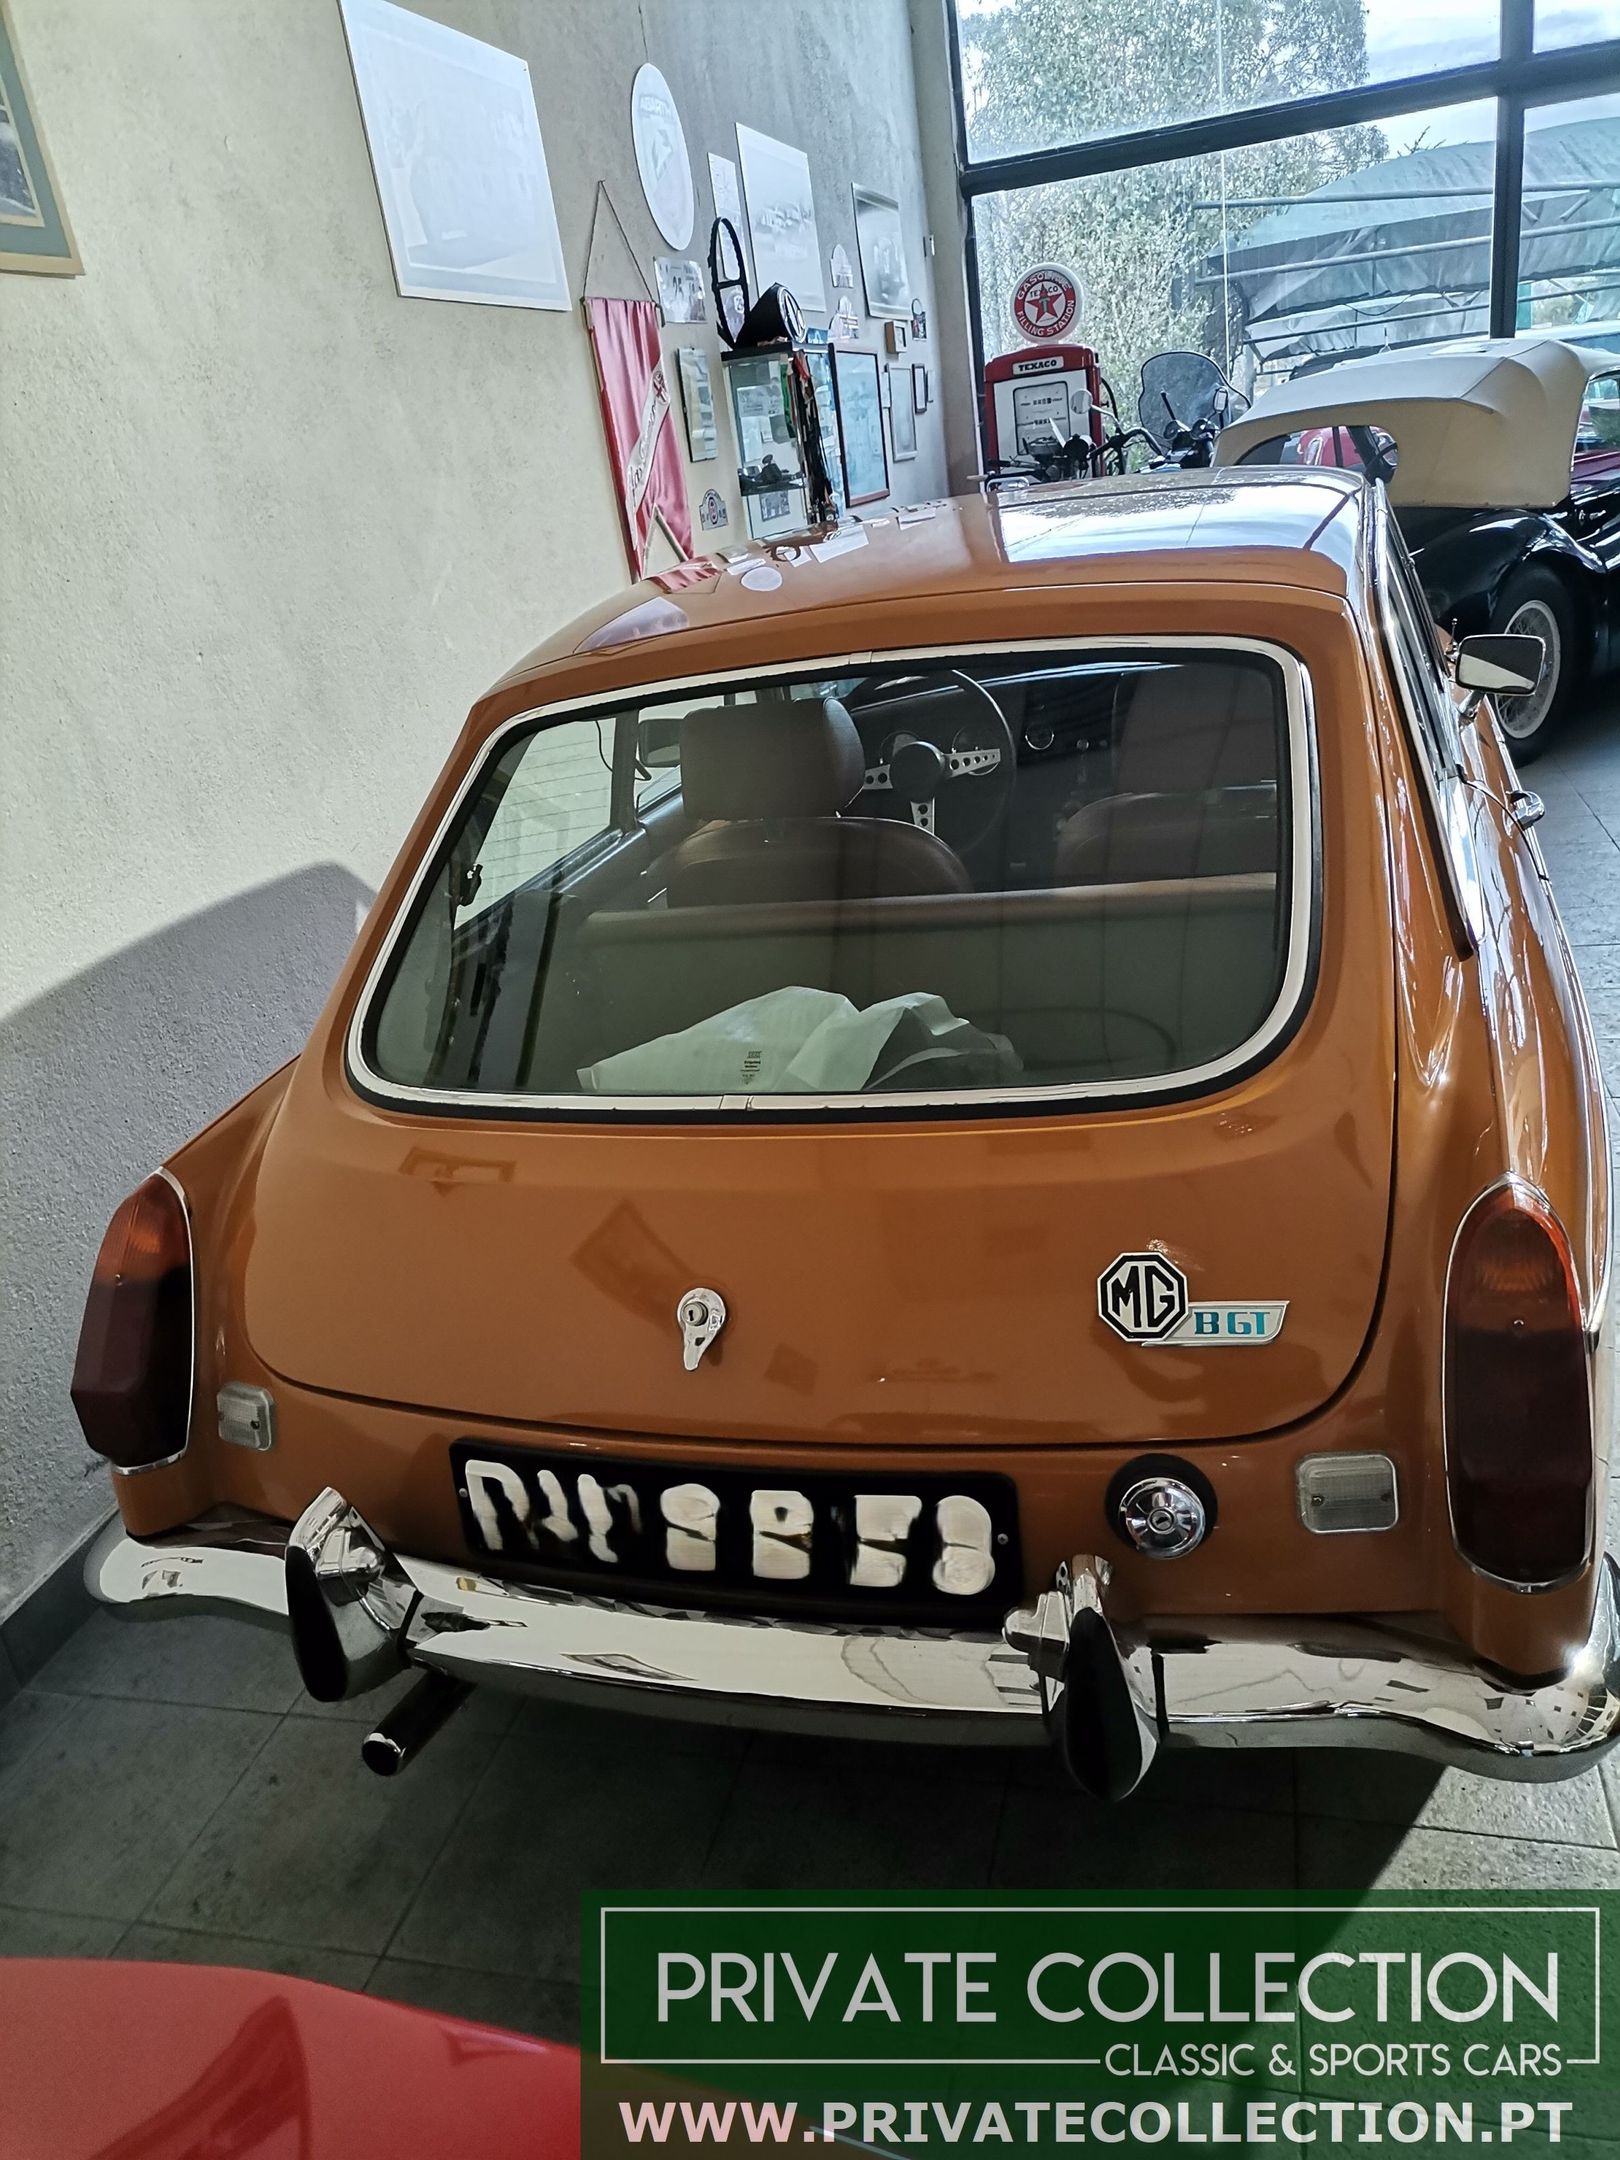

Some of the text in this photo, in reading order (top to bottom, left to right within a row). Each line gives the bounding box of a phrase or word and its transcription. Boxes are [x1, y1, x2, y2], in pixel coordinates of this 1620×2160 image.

[1016, 300, 1075, 336] FILLING STATION
[1018, 359, 1057, 372] TEXACO
[1111, 1265, 1176, 1328] MG
